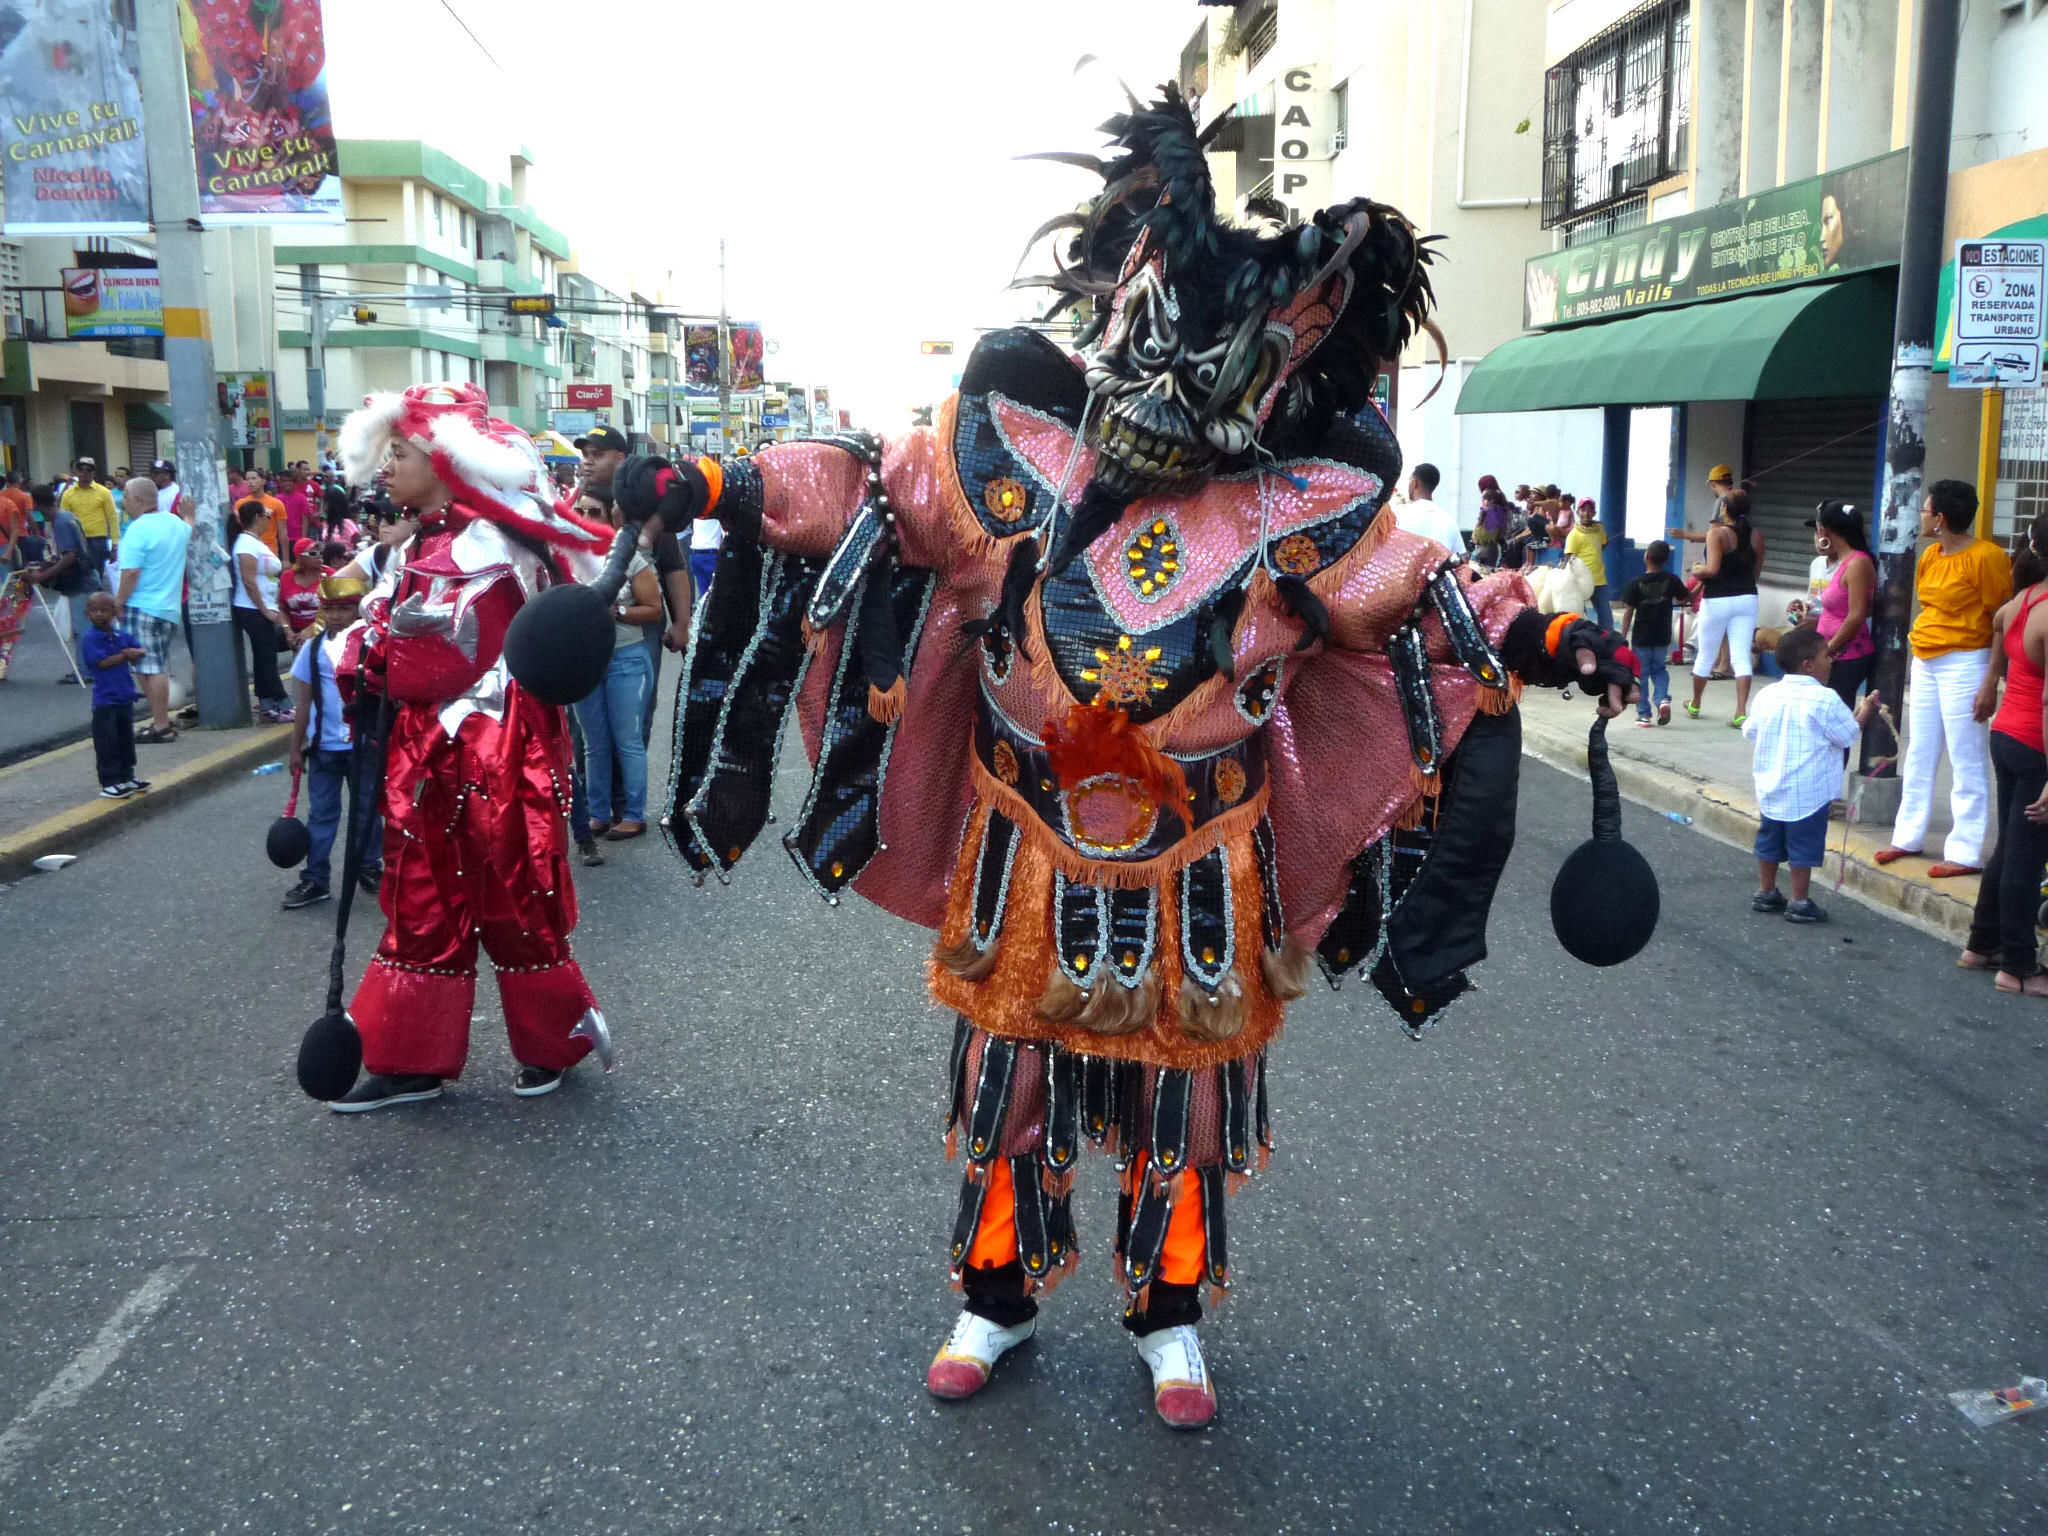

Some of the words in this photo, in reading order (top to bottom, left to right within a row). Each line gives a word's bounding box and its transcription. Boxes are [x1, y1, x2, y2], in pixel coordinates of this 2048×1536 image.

[15, 111, 80, 135] Vive
[89, 101, 120, 121] tu
[8, 117, 140, 161] Carnaval!
[213, 145, 274, 170] Vive
[283, 136, 311, 156] tu
[208, 151, 331, 194] Carnaval!
[1710, 224, 1748, 249] CENTRO
[1748, 220, 1763, 240] DE
[1763, 238, 1778, 257] DE
[1778, 231, 1807, 254] PELO
[1565, 226, 1707, 298] Cindy
[1965, 250, 1981, 264] NO
[1983, 248, 2040, 264] ESTACIONE
[136, 278, 160, 287] DENTA
[1696, 282, 1718, 297] TODAS
[1718, 281, 1727, 293] LA
[1975, 280, 1986, 293] E
[1623, 283, 1673, 308] Nails
[2004, 284, 2036, 298] ZONA
[1971, 300, 2035, 310] RESERVADA
[1970, 313, 2035, 322] TRANSPORTE
[1993, 325, 2034, 335] URBANO
[576, 390, 599, 399] Claro
